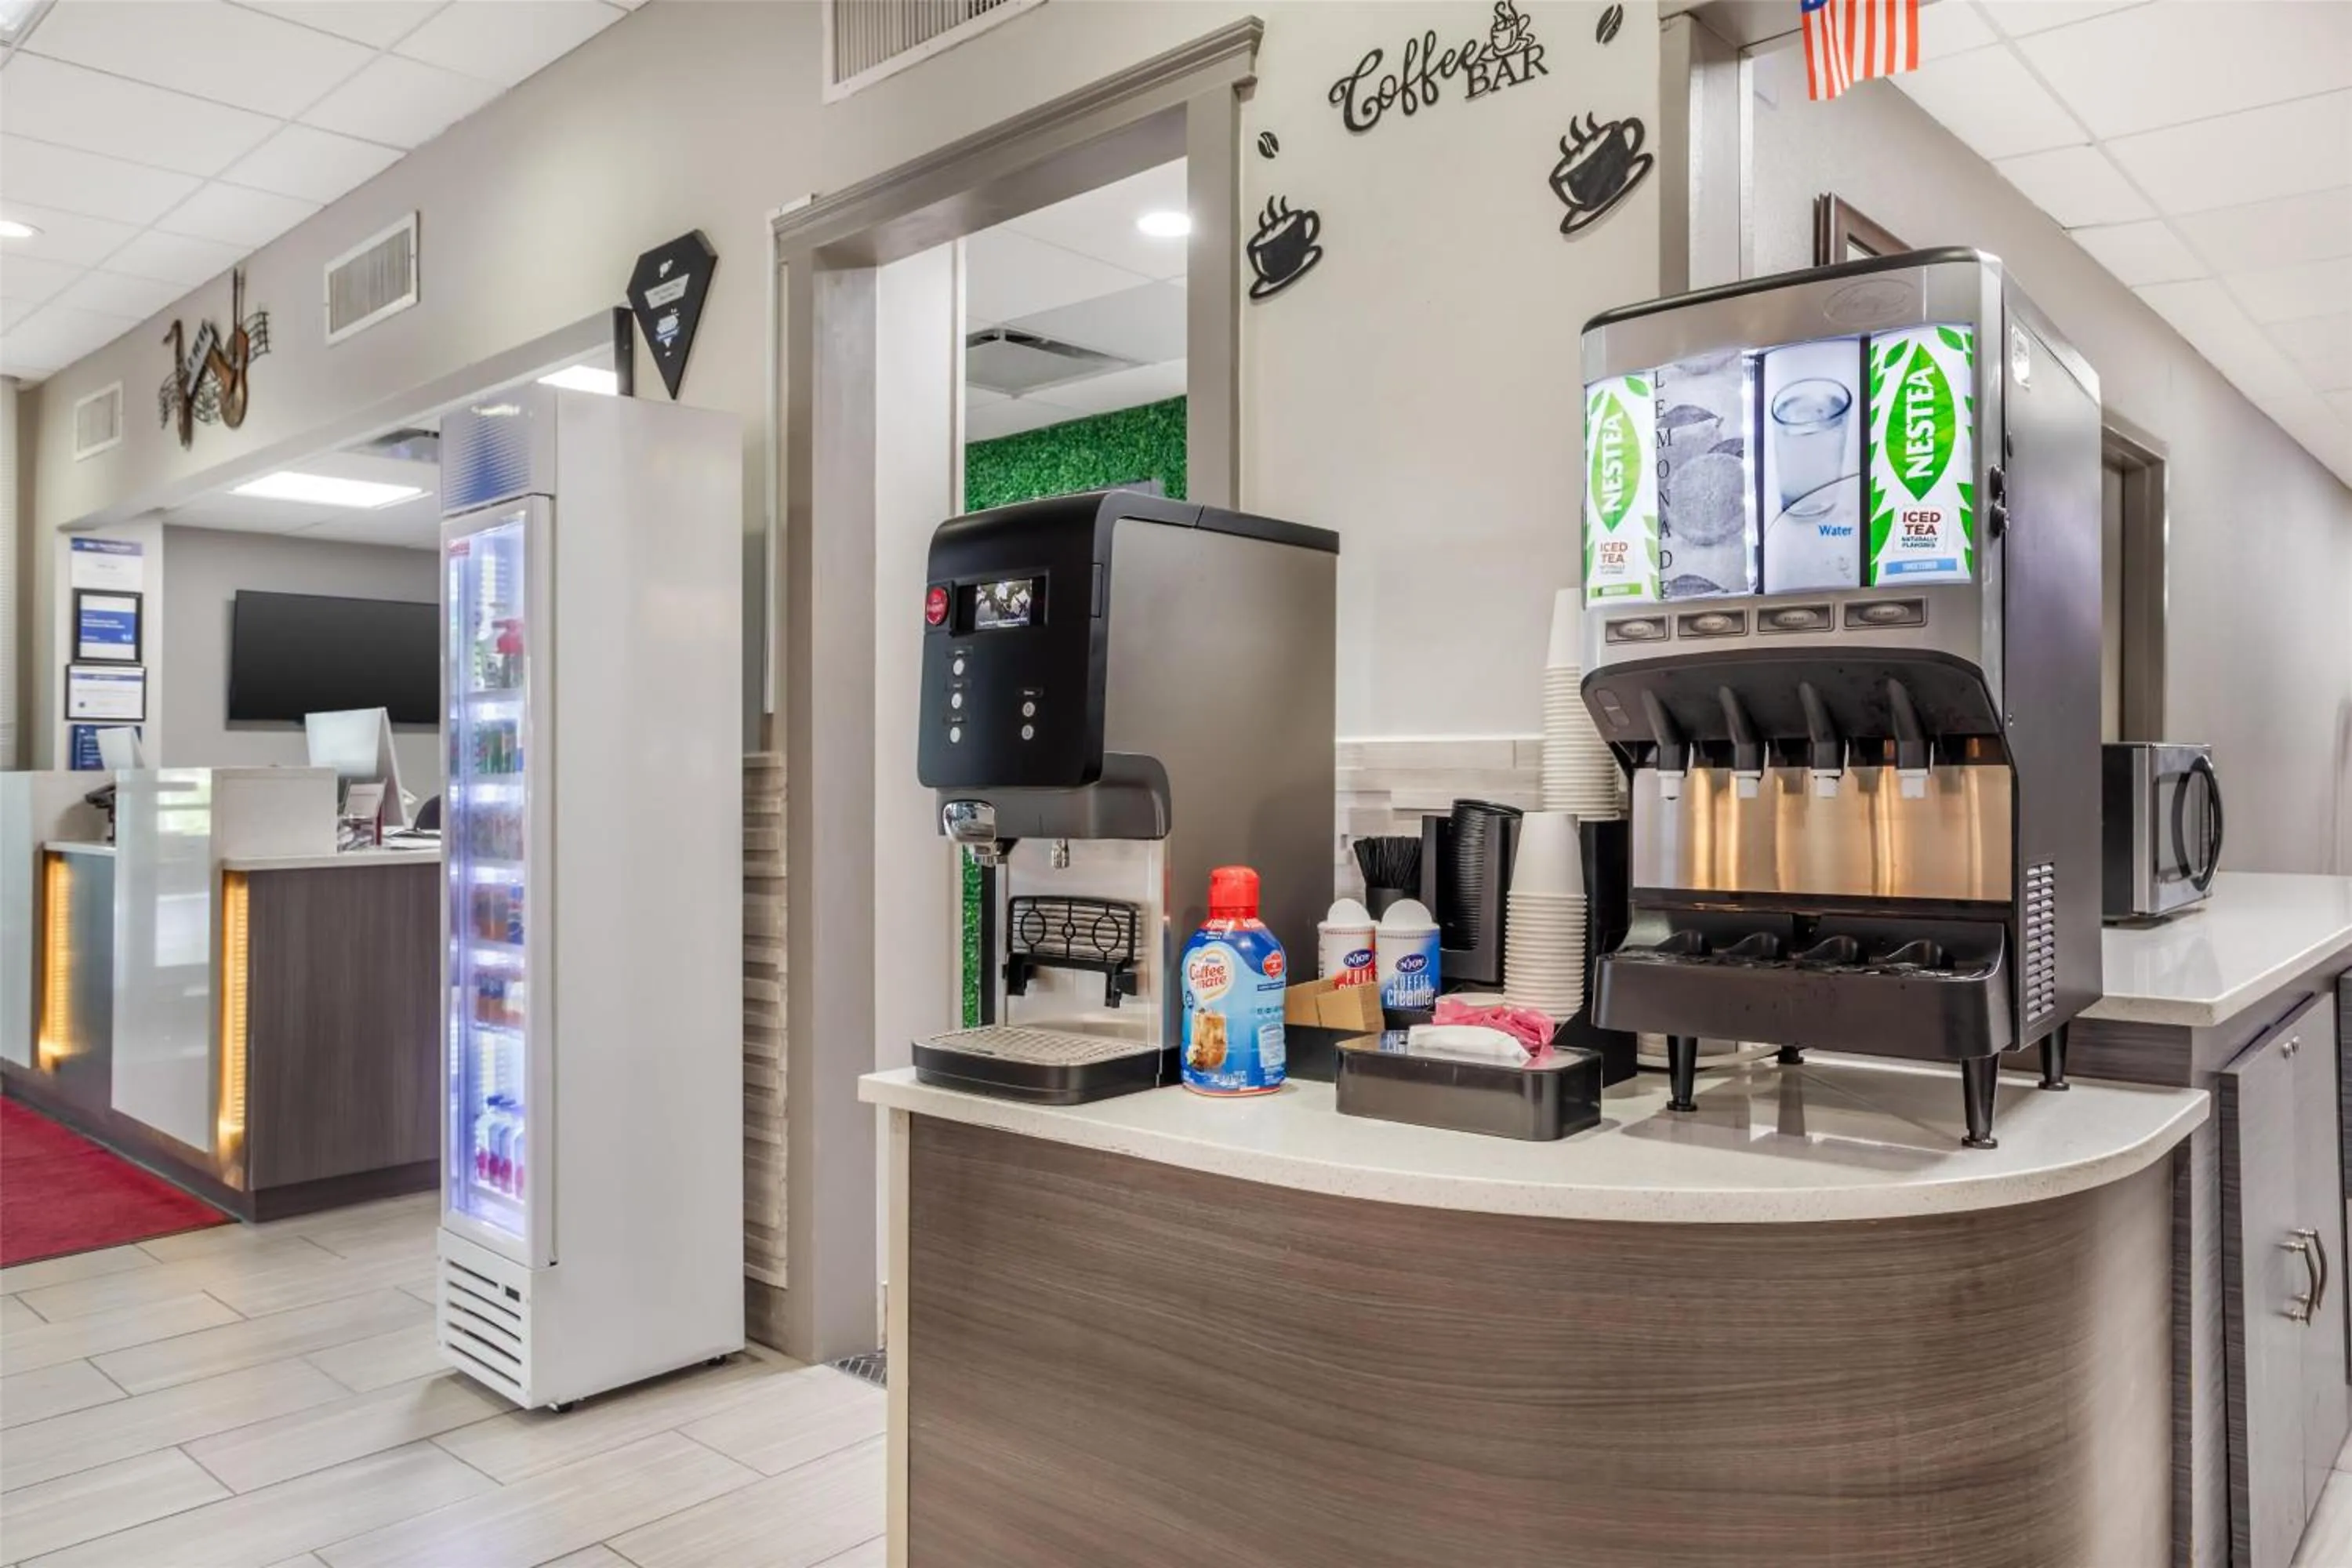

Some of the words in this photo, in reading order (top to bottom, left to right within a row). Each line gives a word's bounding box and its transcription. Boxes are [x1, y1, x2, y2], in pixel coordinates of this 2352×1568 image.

[1465, 45, 1549, 99] BAR
[1328, 30, 1485, 132] Coffee
[1906, 365, 1935, 479] NESTEA
[1602, 412, 1623, 514] NESTEA
[1903, 512, 1941, 523] ICED
[1818, 524, 1853, 537] Water
[1904, 524, 1936, 535] TEA
[1600, 542, 1628, 553] ICED
[1602, 553, 1624, 564] TEA
[1189, 964, 1225, 980] Coffee
[1393, 974, 1430, 990] COFFEE
[1387, 987, 1436, 1007] creamer
